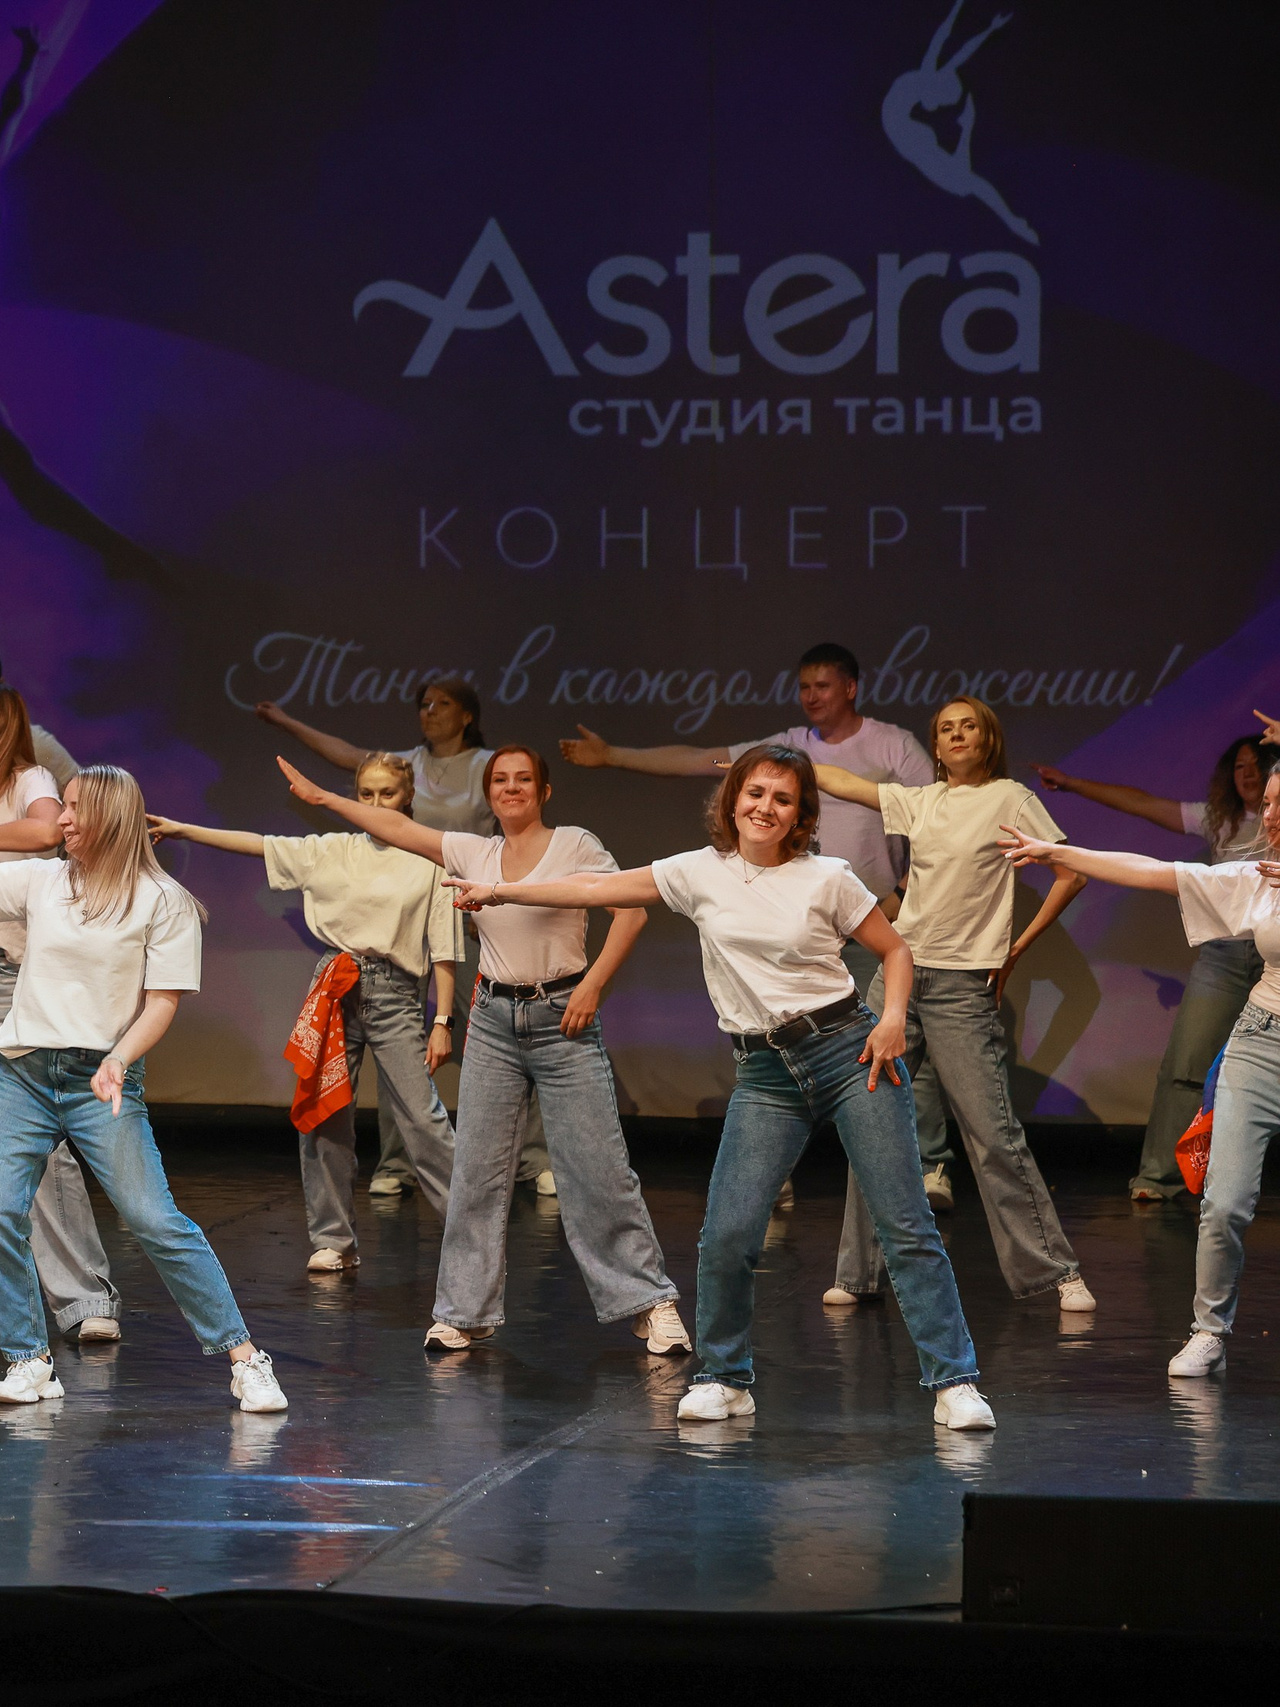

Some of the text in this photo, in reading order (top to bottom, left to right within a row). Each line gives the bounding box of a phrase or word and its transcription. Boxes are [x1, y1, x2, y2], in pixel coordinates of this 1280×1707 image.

[352, 216, 1042, 377] Astera
[568, 396, 1043, 447] студия танца
[420, 505, 987, 581] КОНЦЕРТ
[225, 631, 479, 711] Тан
[491, 624, 555, 705] в
